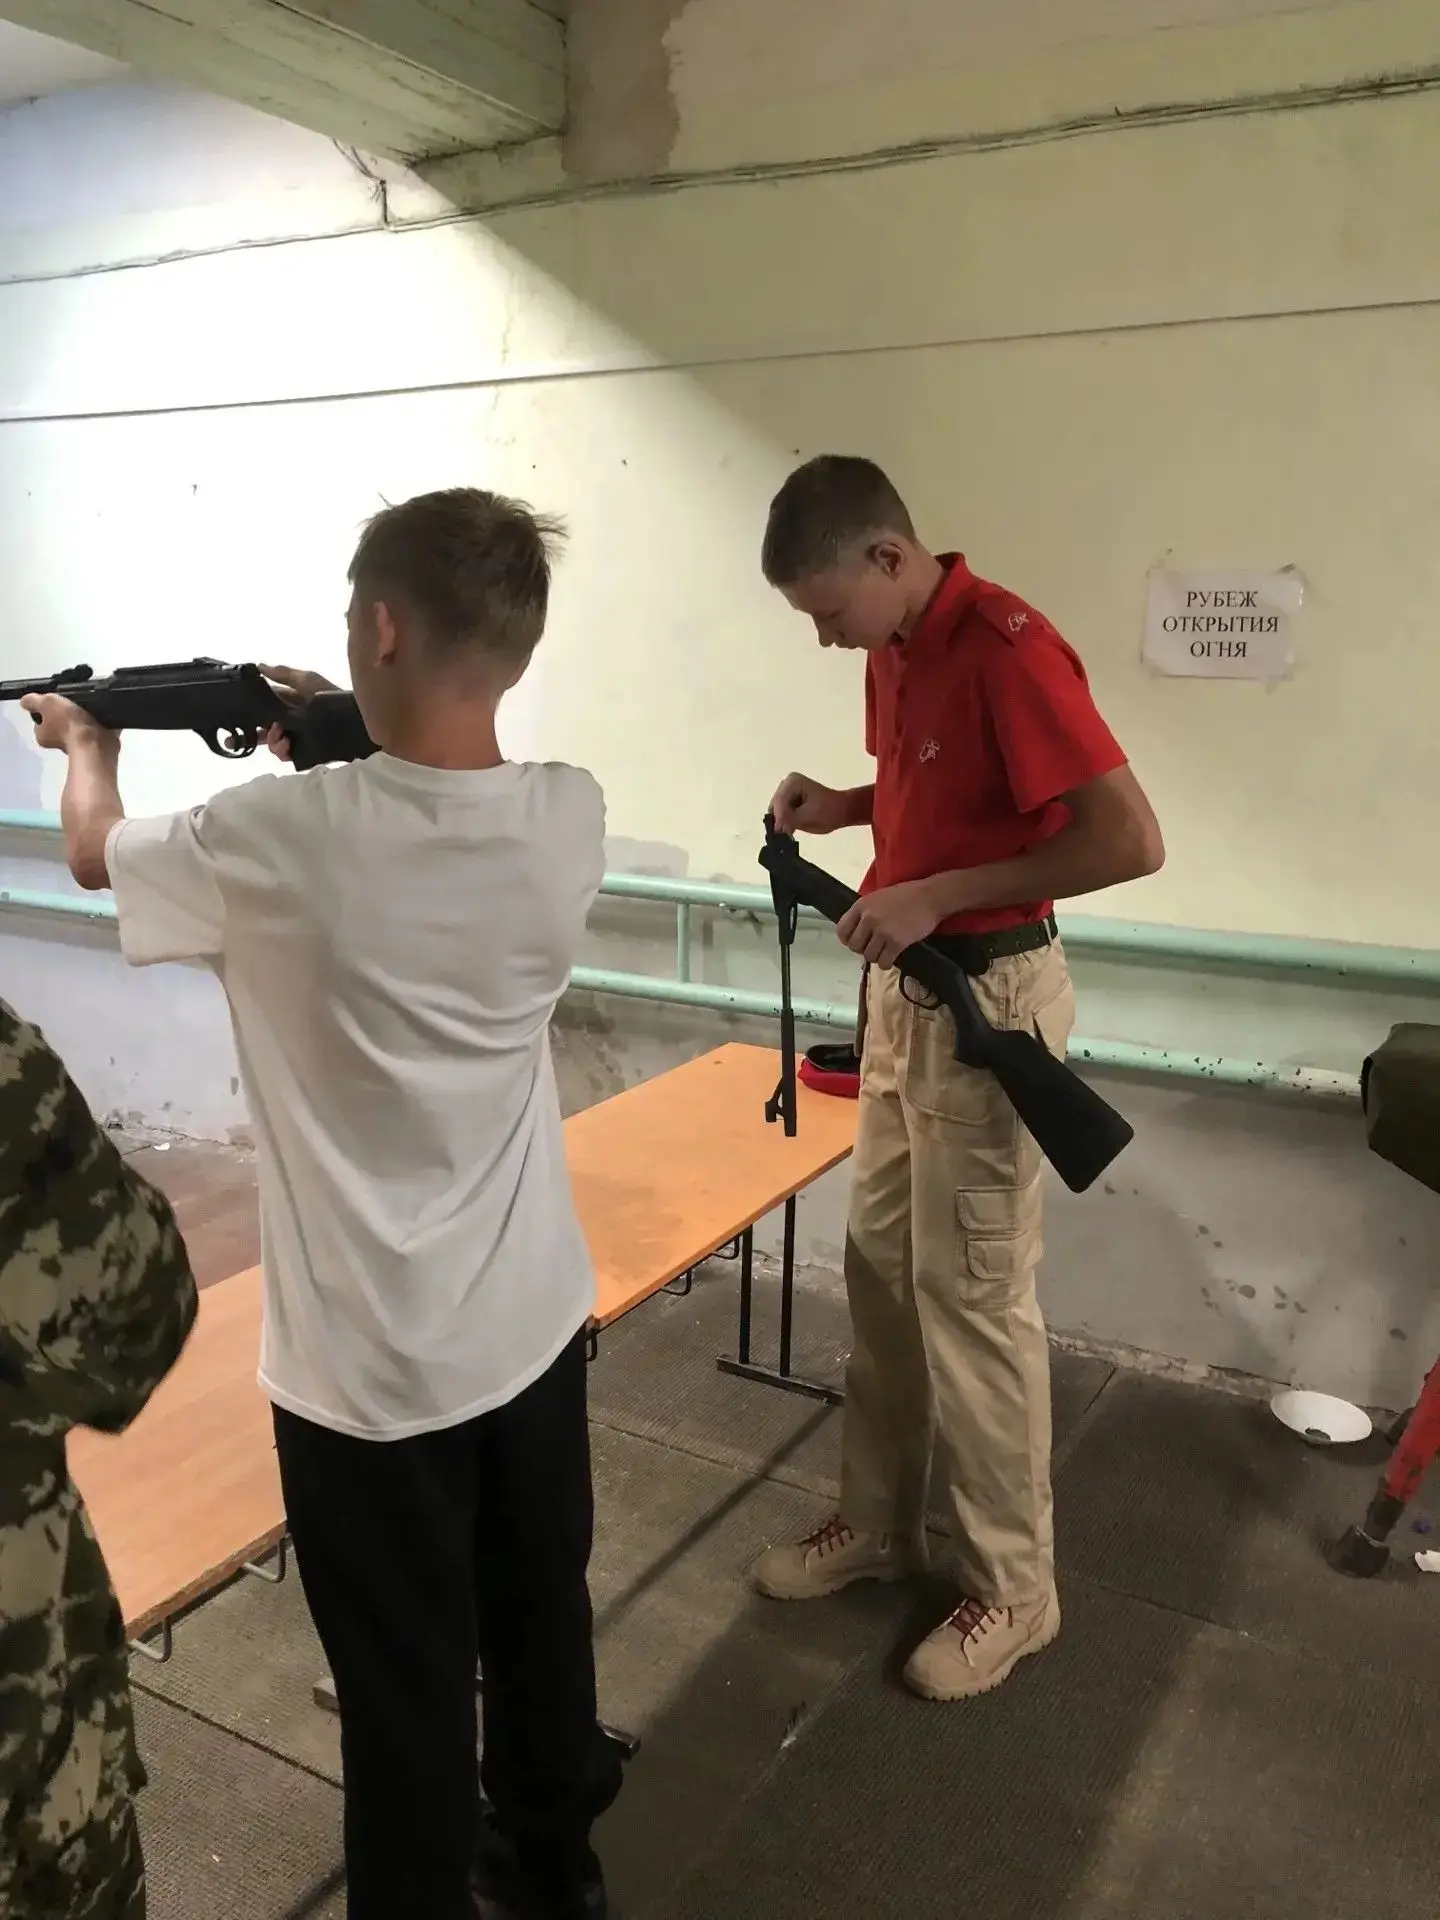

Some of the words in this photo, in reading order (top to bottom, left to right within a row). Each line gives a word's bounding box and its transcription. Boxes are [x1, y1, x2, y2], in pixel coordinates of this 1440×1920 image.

[1187, 591, 1258, 608] РУБЕЖ
[1162, 616, 1279, 633] ОТКРЫТИЯ
[1190, 641, 1247, 658] ОГНЯ
